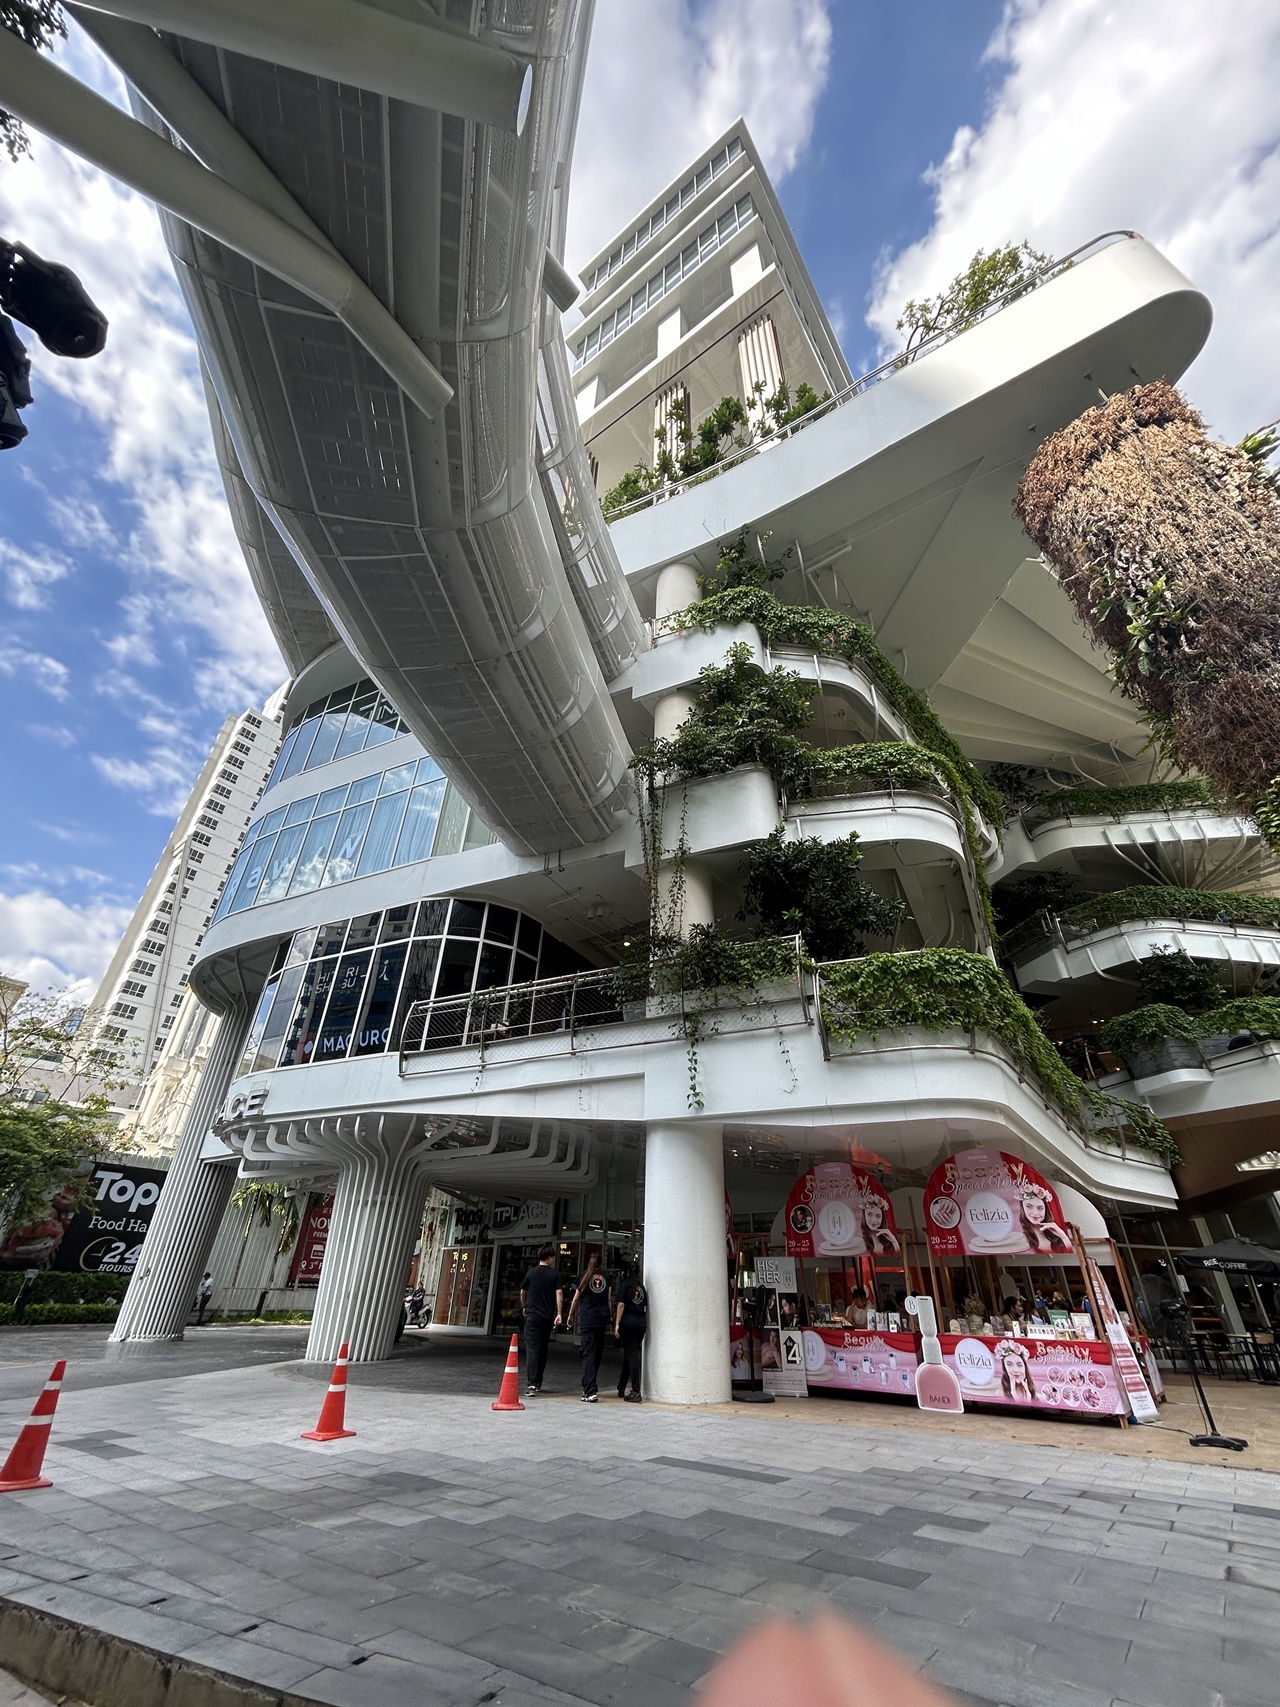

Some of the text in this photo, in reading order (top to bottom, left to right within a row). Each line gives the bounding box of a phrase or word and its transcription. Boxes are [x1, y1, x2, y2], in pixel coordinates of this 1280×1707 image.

[945, 1162, 1024, 1180] Beauty
[806, 1174, 869, 1192] Beauty
[941, 1174, 1029, 1195] Special Week
[94, 1170, 160, 1213] Top
[801, 1187, 836, 1203] Special
[969, 1208, 1010, 1222] Felizia
[88, 1216, 149, 1233] Food Ha
[930, 1236, 940, 1244] 20
[102, 1241, 144, 1264] 24
[97, 1264, 134, 1273] HOURS
[757, 1260, 775, 1271] HIS
[1203, 1258, 1248, 1270] RISE COFFEE
[758, 1271, 781, 1284] HER
[1036, 1341, 1090, 1358] Beauty
[958, 1352, 992, 1367] Felizia
[1034, 1351, 1064, 1365] Special
[929, 1395, 951, 1405] BANDI
